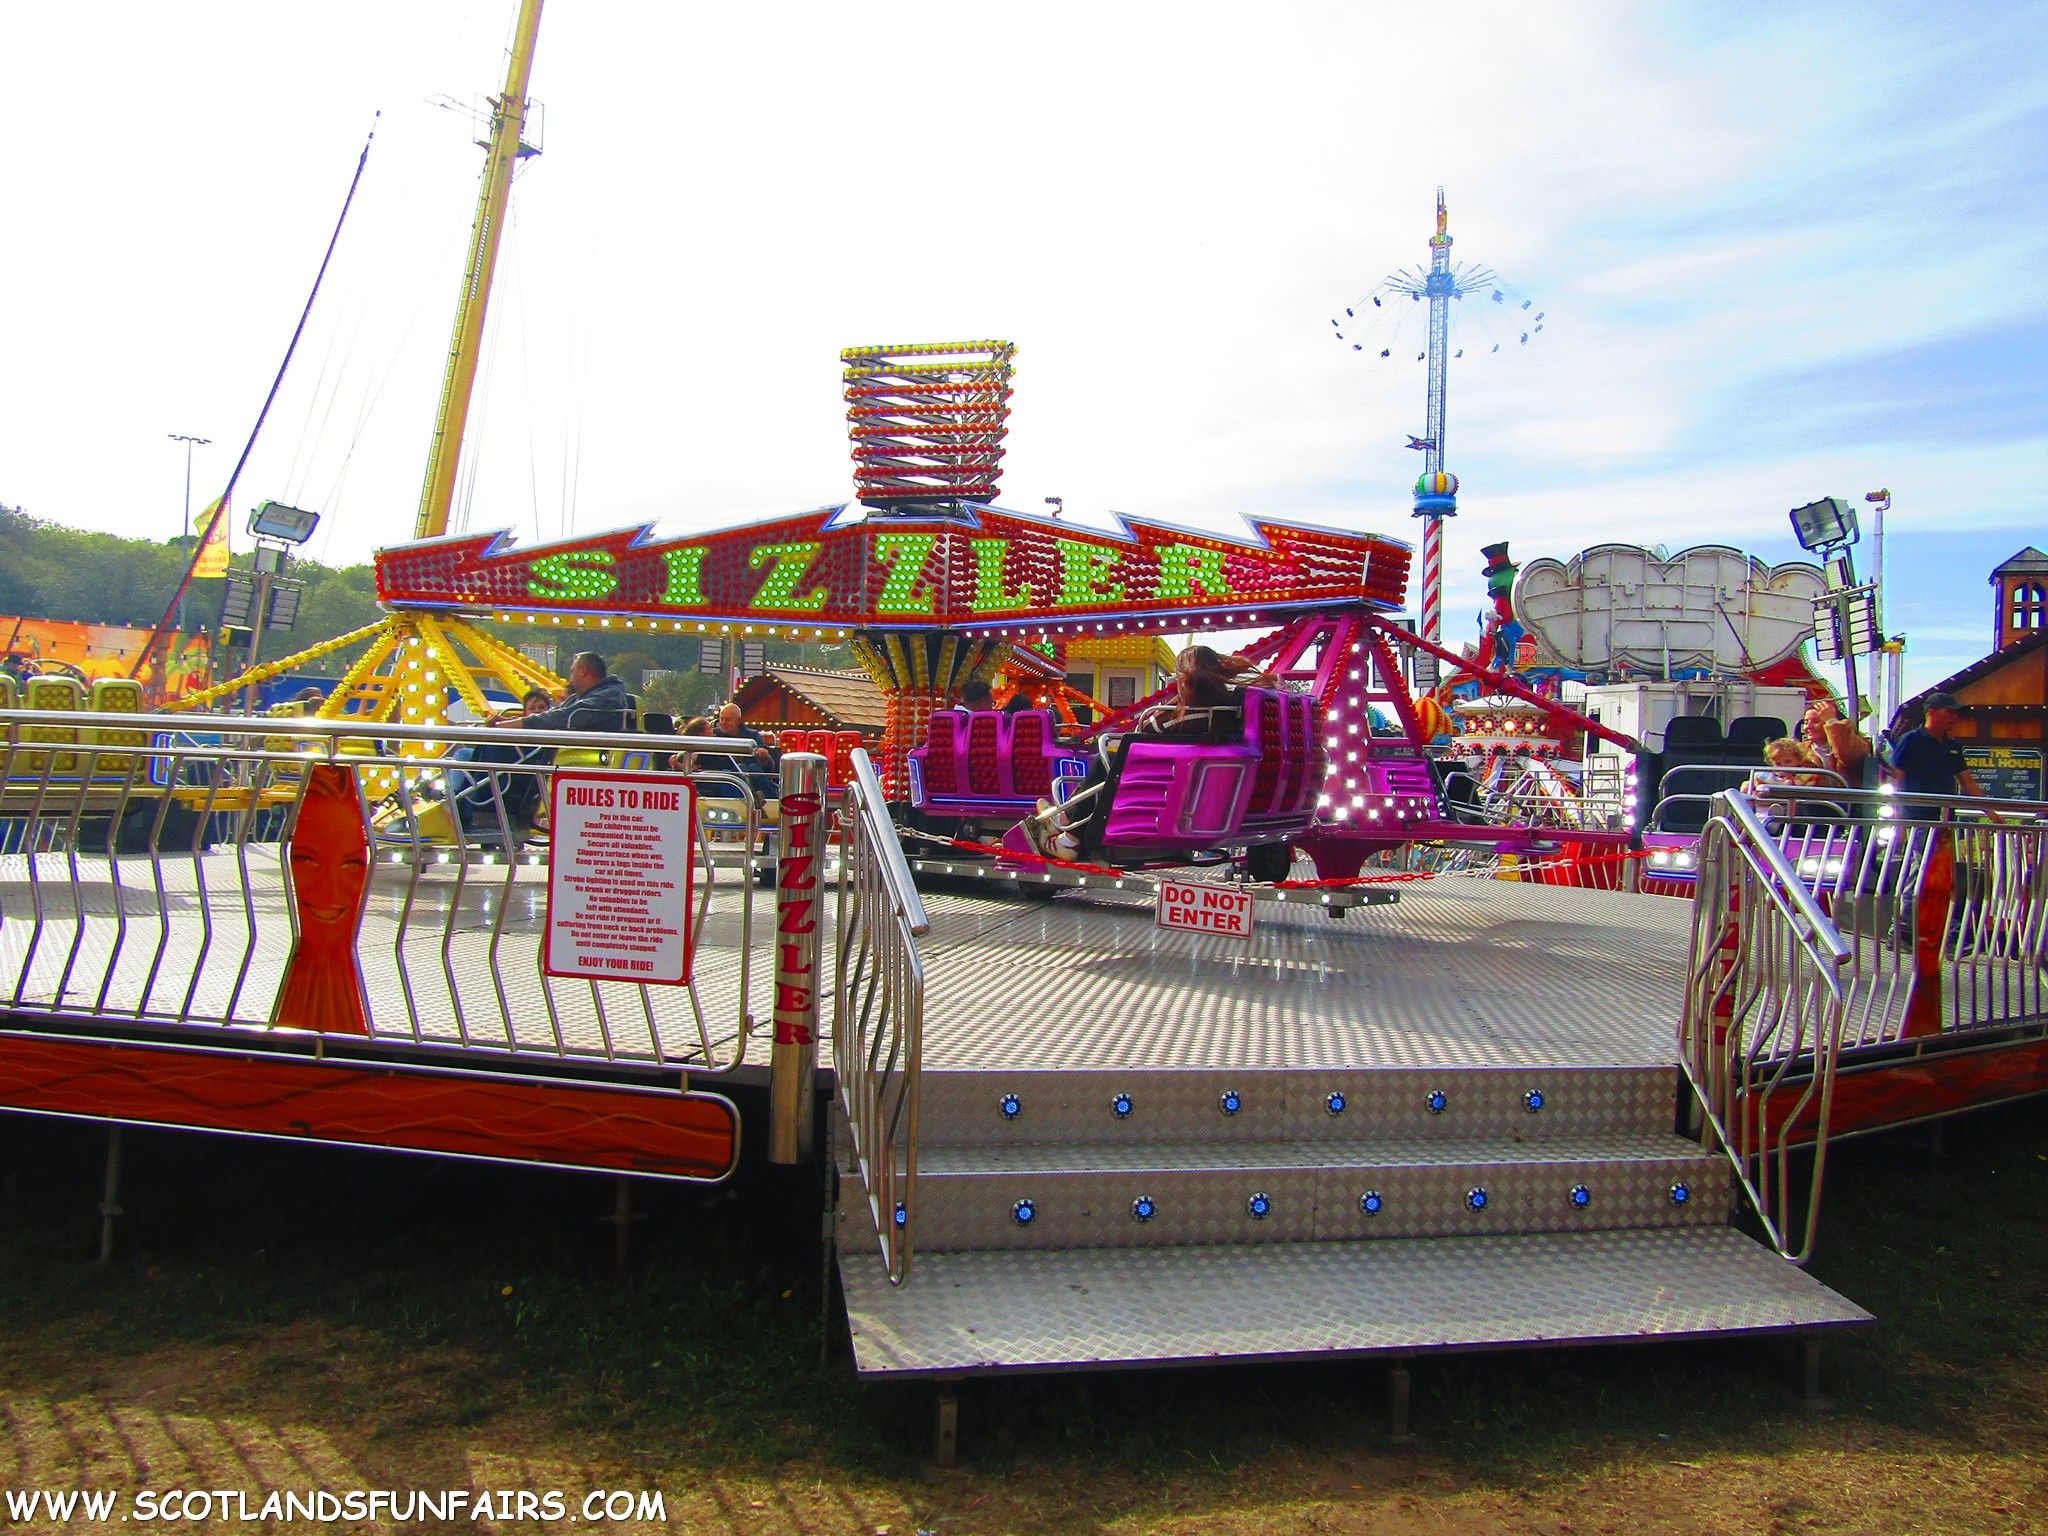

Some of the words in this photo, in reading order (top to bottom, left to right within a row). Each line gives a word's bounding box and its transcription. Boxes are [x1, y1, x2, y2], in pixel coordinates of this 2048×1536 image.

[529, 534, 1232, 613] SIZZLER
[1990, 749, 2012, 758] THE
[1998, 758, 2041, 768] HOUSE
[566, 787, 614, 807] RULES
[618, 790, 638, 808] TO
[643, 791, 679, 810] RIDE
[577, 849, 604, 857] Slippery
[586, 877, 611, 885] lighting
[613, 887, 640, 896] drugged
[1165, 886, 1196, 905] DO
[1203, 892, 1248, 912] NOT
[617, 915, 646, 923] pregnant
[773, 792, 822, 1045] SIZZLER
[1168, 906, 1242, 930] ENTER
[557, 920, 586, 928] suffering
[592, 942, 628, 950] completely
[579, 956, 603, 967] ENJOY
[606, 958, 628, 969] YOUR
[631, 960, 653, 971] RIDE!
